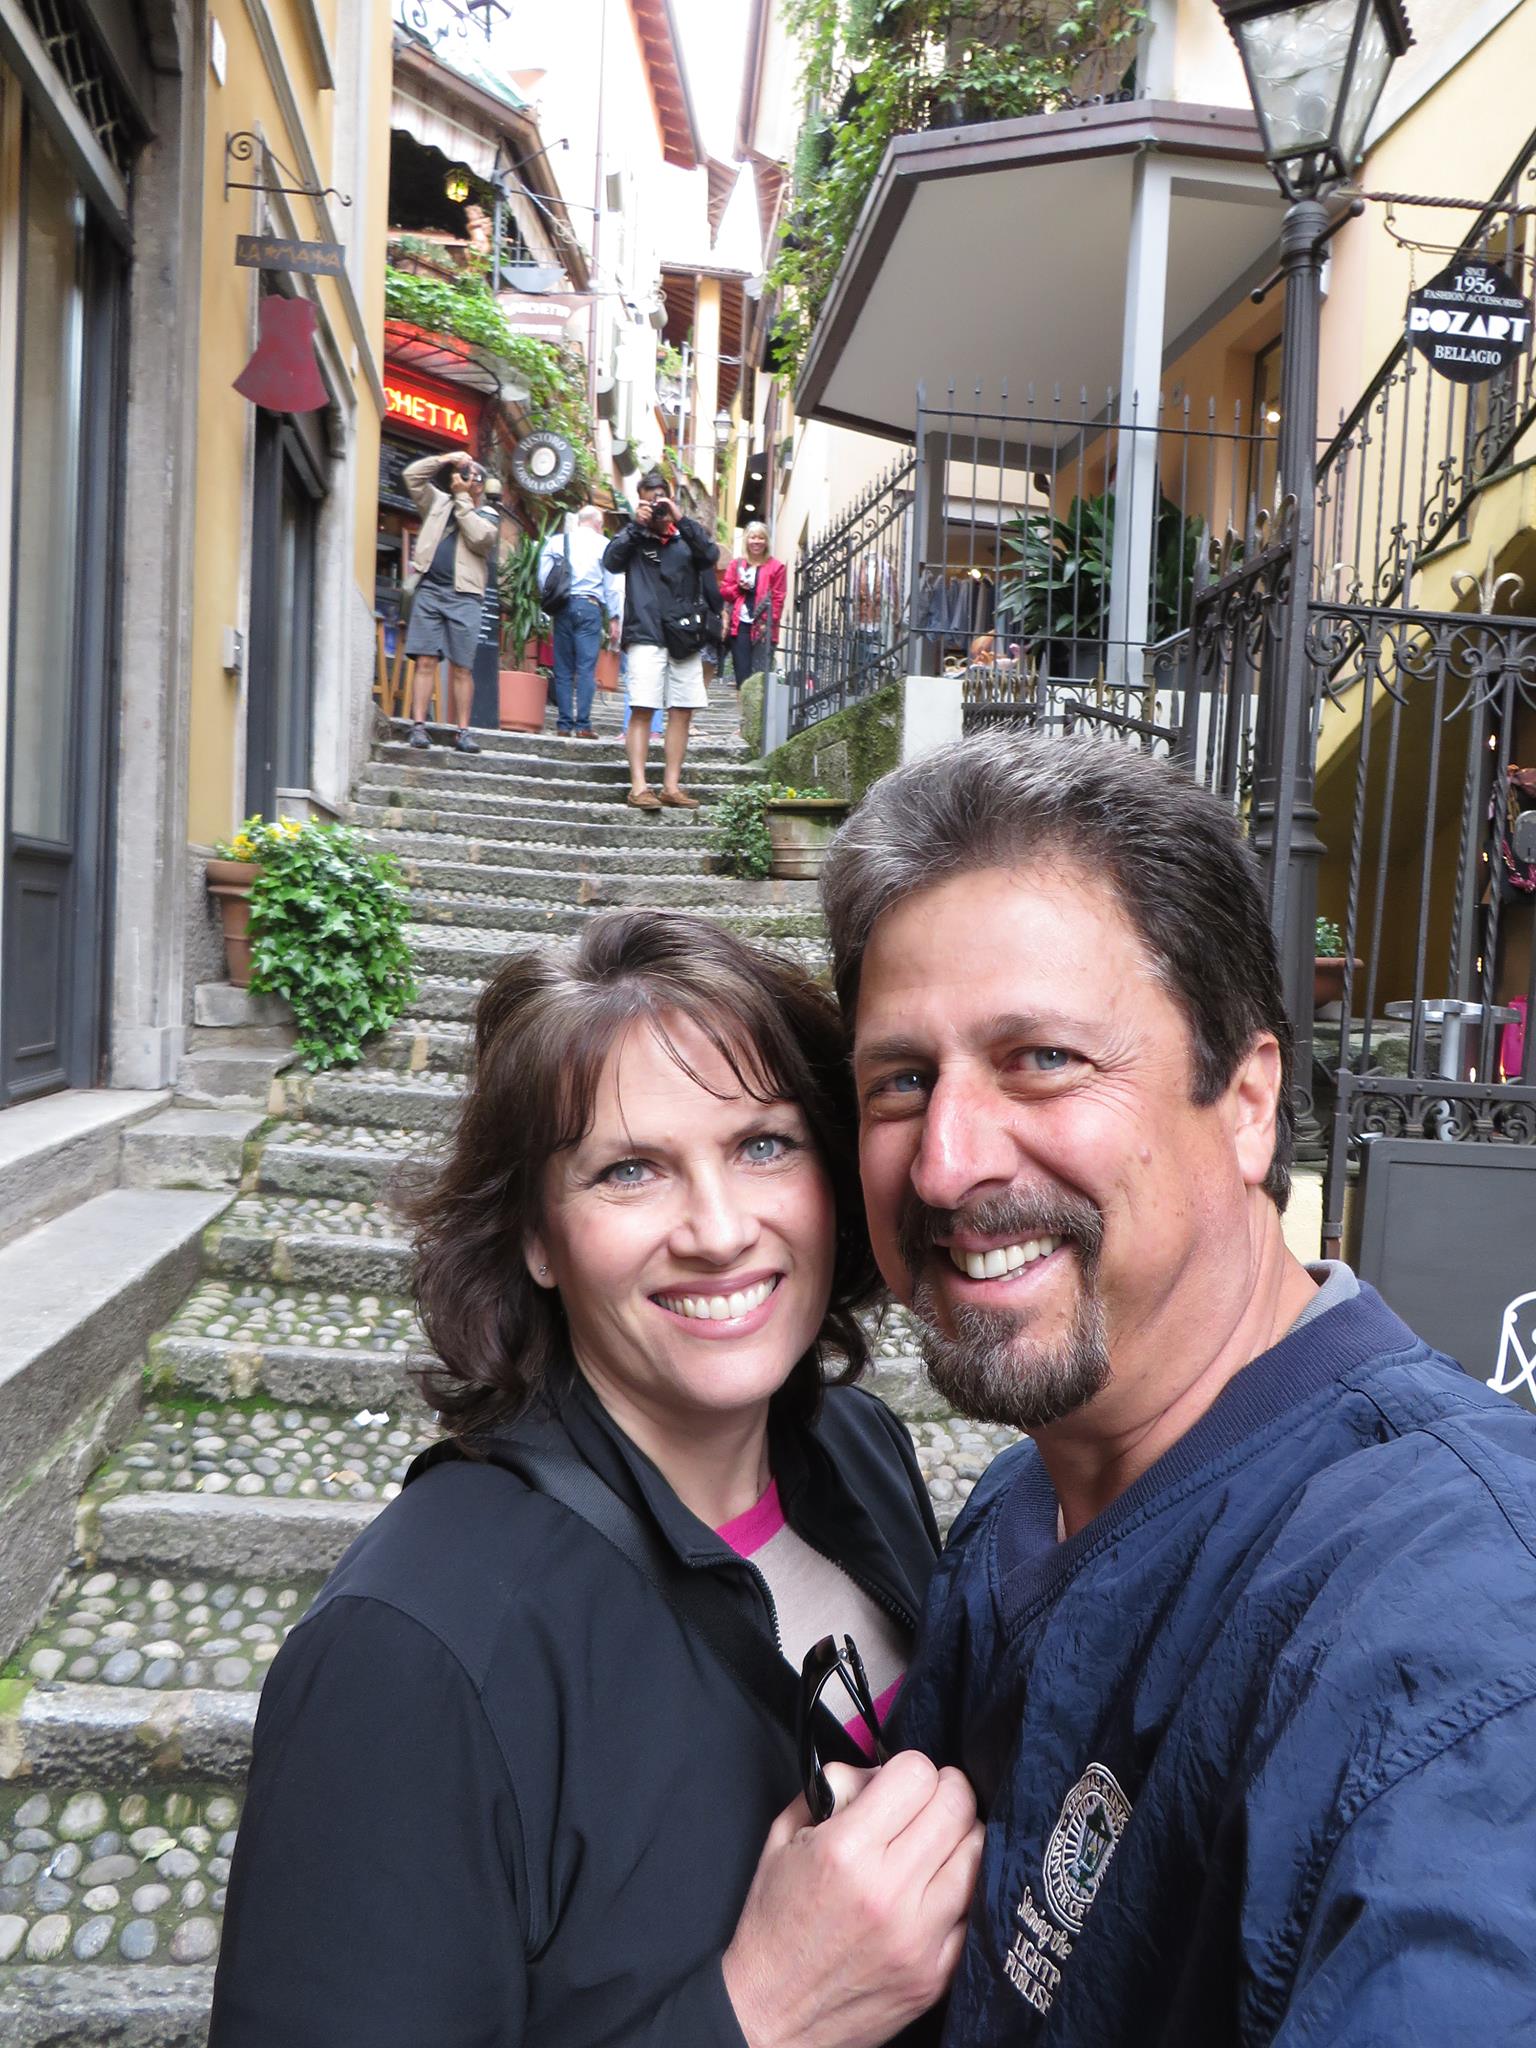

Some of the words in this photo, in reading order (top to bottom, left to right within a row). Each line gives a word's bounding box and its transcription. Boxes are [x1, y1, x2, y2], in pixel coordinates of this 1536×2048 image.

[1454, 275, 1496, 295] 1956
[1423, 288, 1466, 302] FASHION
[1466, 295, 1524, 308] ACCESSORIES
[1409, 306, 1531, 342] BOZART
[1434, 344, 1502, 365] BELLAGIO
[520, 433, 567, 451] RISTORO
[1050, 1929, 1073, 1961] the
[1013, 1930, 1062, 1991] LIGHTP
